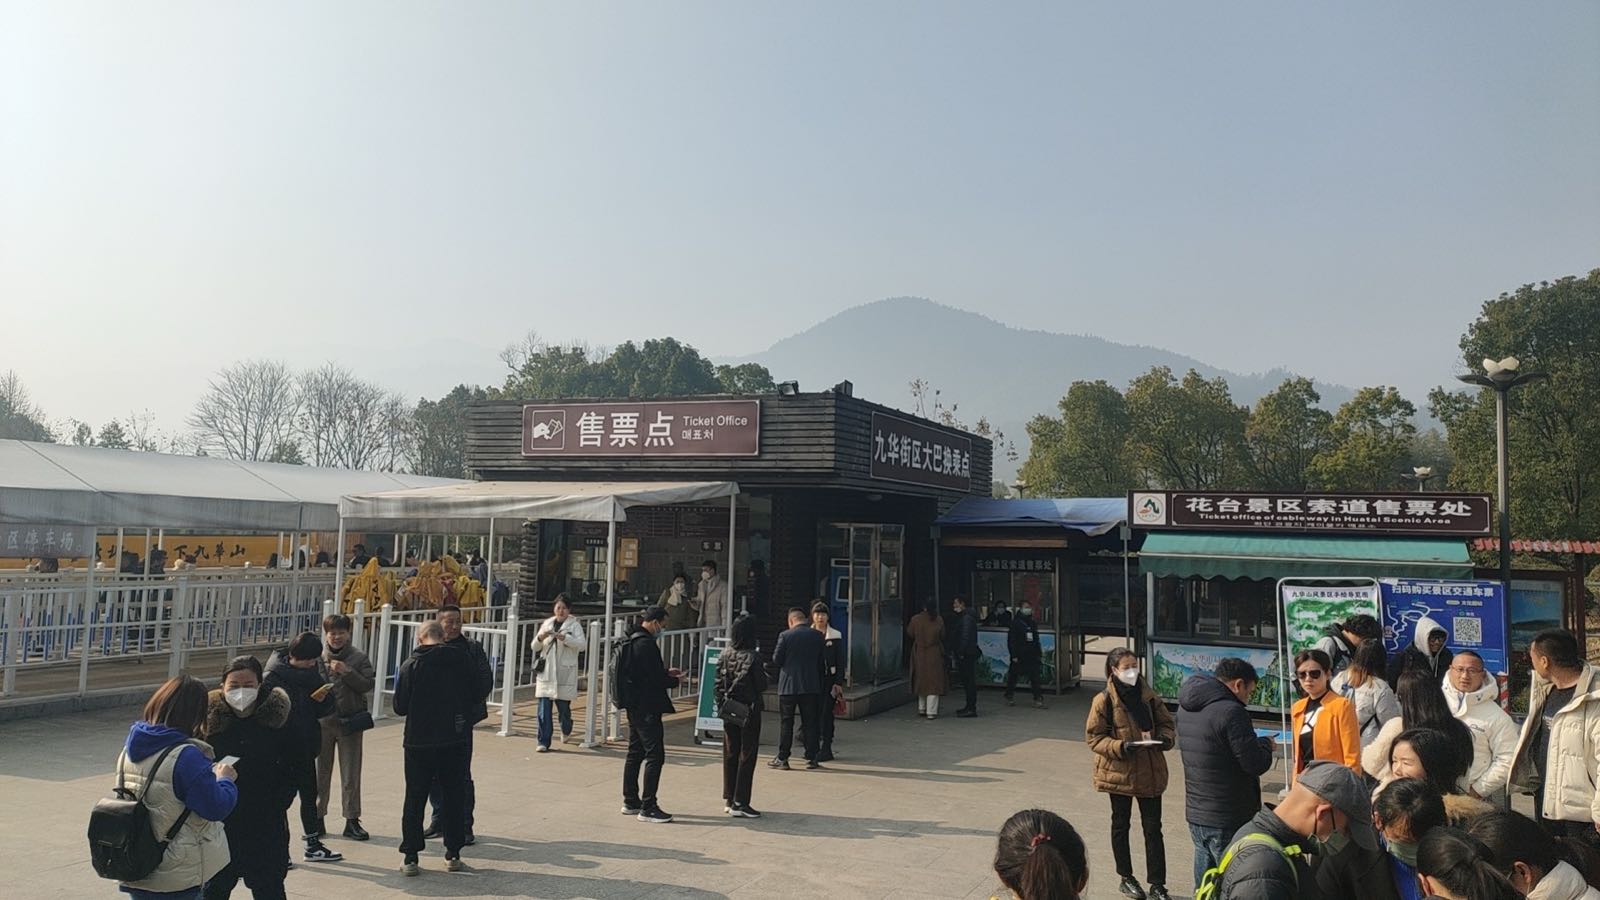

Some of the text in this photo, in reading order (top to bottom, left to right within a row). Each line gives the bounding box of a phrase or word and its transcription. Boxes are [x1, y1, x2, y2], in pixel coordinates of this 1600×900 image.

[682, 414, 748, 427] Ticket Office
[575, 410, 674, 448] 售票点
[874, 429, 970, 478] 九华街区大巴换乘点
[1185, 497, 1473, 517] 花台景区索道售票处
[1232, 513, 1262, 521] office
[1383, 516, 1422, 524] Scenic
[1391, 585, 1494, 598] 扫码购买景区交通车票
